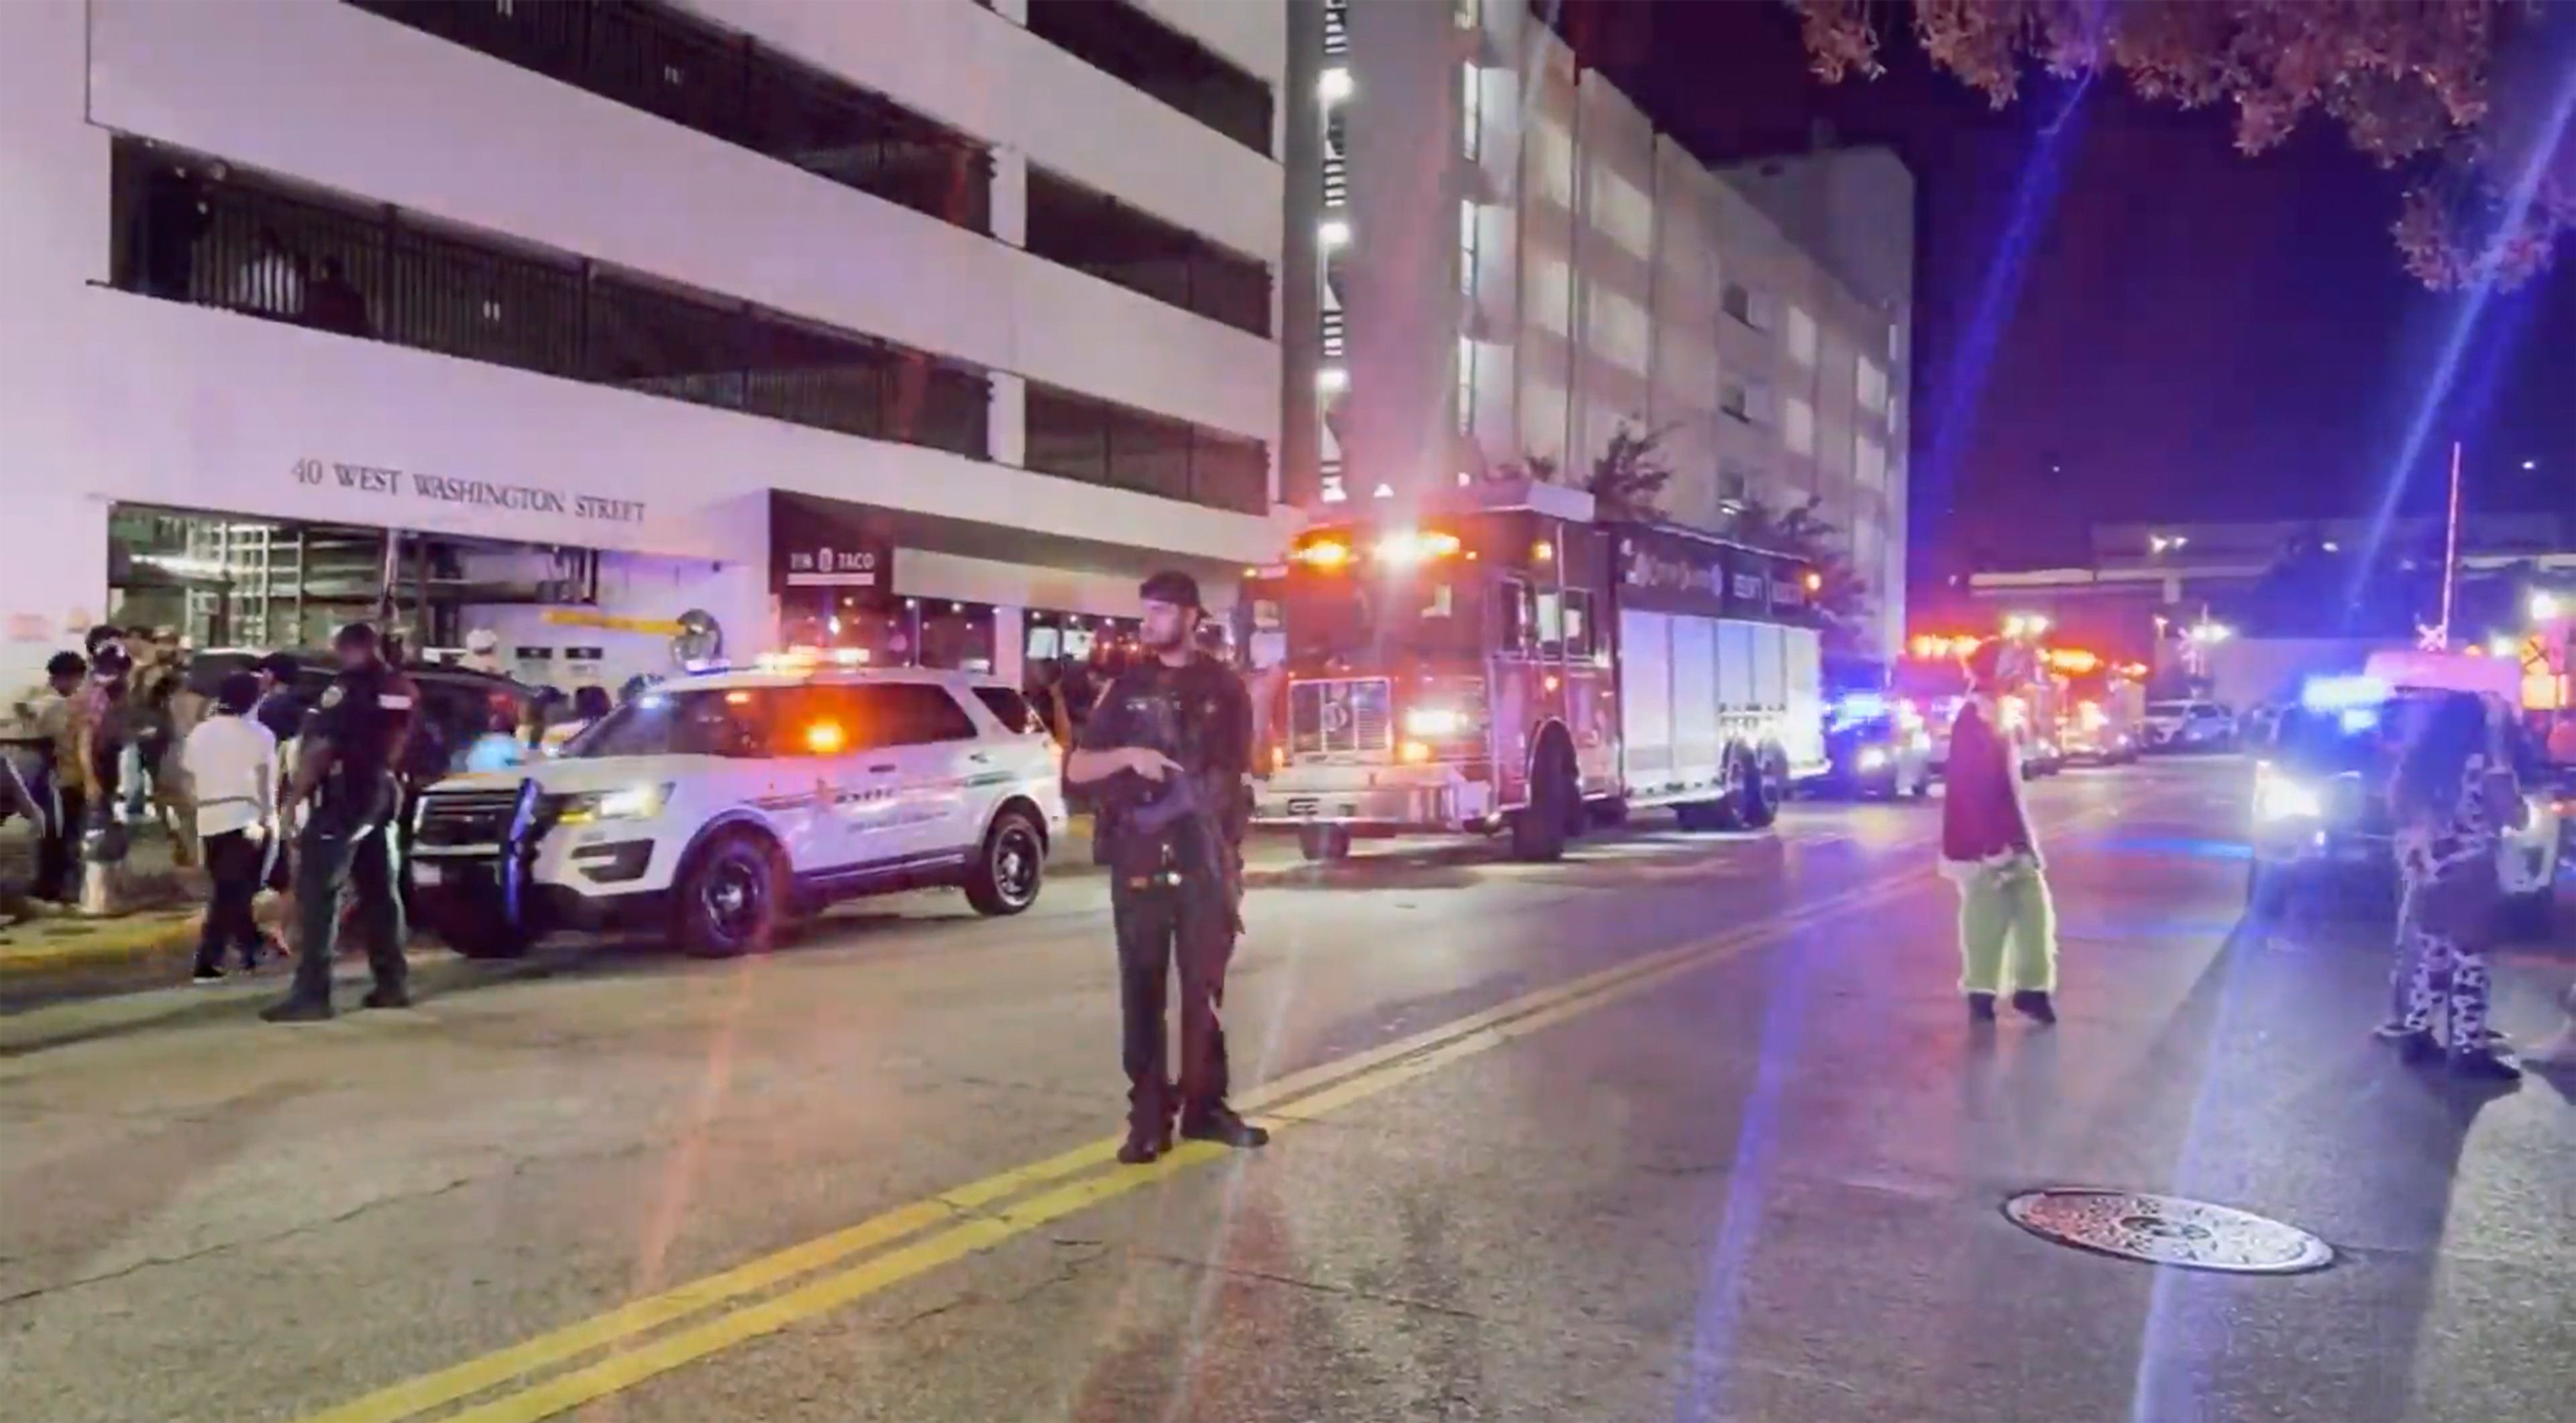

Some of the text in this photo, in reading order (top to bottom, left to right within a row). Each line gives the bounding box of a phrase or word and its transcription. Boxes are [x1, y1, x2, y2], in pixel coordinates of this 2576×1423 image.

[290, 458, 645, 522] 40 WEST WASHINGTON STREET
[838, 553, 874, 570] TACO
